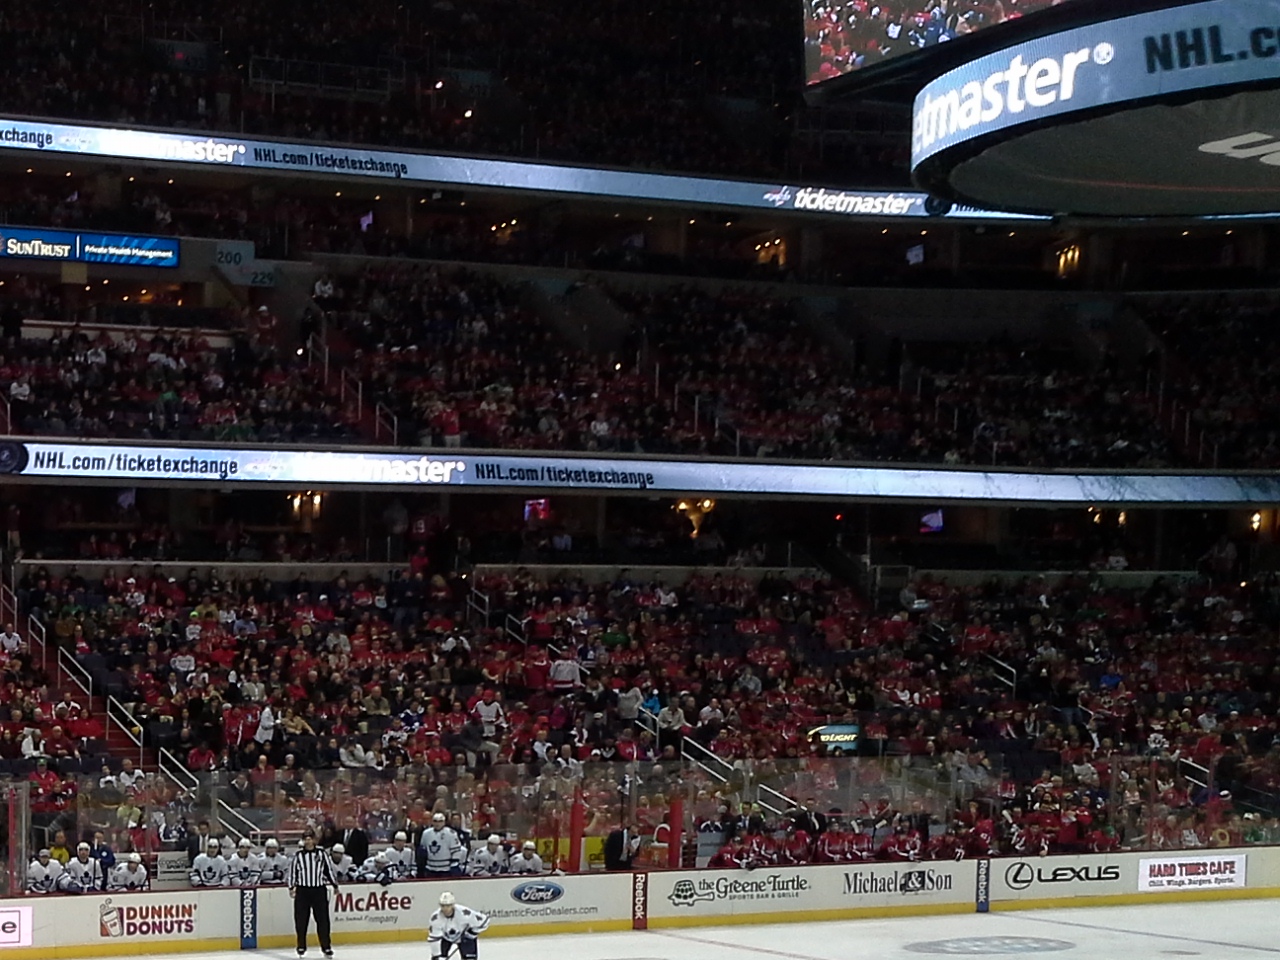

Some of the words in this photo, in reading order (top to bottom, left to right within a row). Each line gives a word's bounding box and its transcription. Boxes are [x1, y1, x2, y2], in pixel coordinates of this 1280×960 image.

[1143, 25, 1280, 74] NHL.c
[913, 47, 1090, 154] etmaster
[253, 147, 408, 178] NHL.com/ticketexchange
[794, 187, 915, 215] ticketmaster
[217, 251, 242, 265] 200
[33, 451, 238, 480] NHL.com/ticketexchange
[475, 463, 654, 489] NHL.com/ticketexchange
[843, 870, 898, 895] Michael
[925, 868, 953, 891] Son
[979, 859, 988, 903] Reebok
[1037, 865, 1120, 882] LEXUS
[1149, 863, 1176, 878] HARD
[1210, 860, 1236, 875] CAFE
[521, 884, 554, 901] Ford
[635, 873, 645, 919] Reebok
[698, 878, 715, 891] the
[716, 877, 767, 899] Greene
[766, 874, 808, 892] Turtle
[126, 904, 198, 920] DUNKIN'
[243, 890, 254, 938] Reebok
[334, 890, 413, 914] McAfee
[480, 906, 599, 919] idAtlanticFordDealers.com
[126, 919, 194, 936] DONUTS
